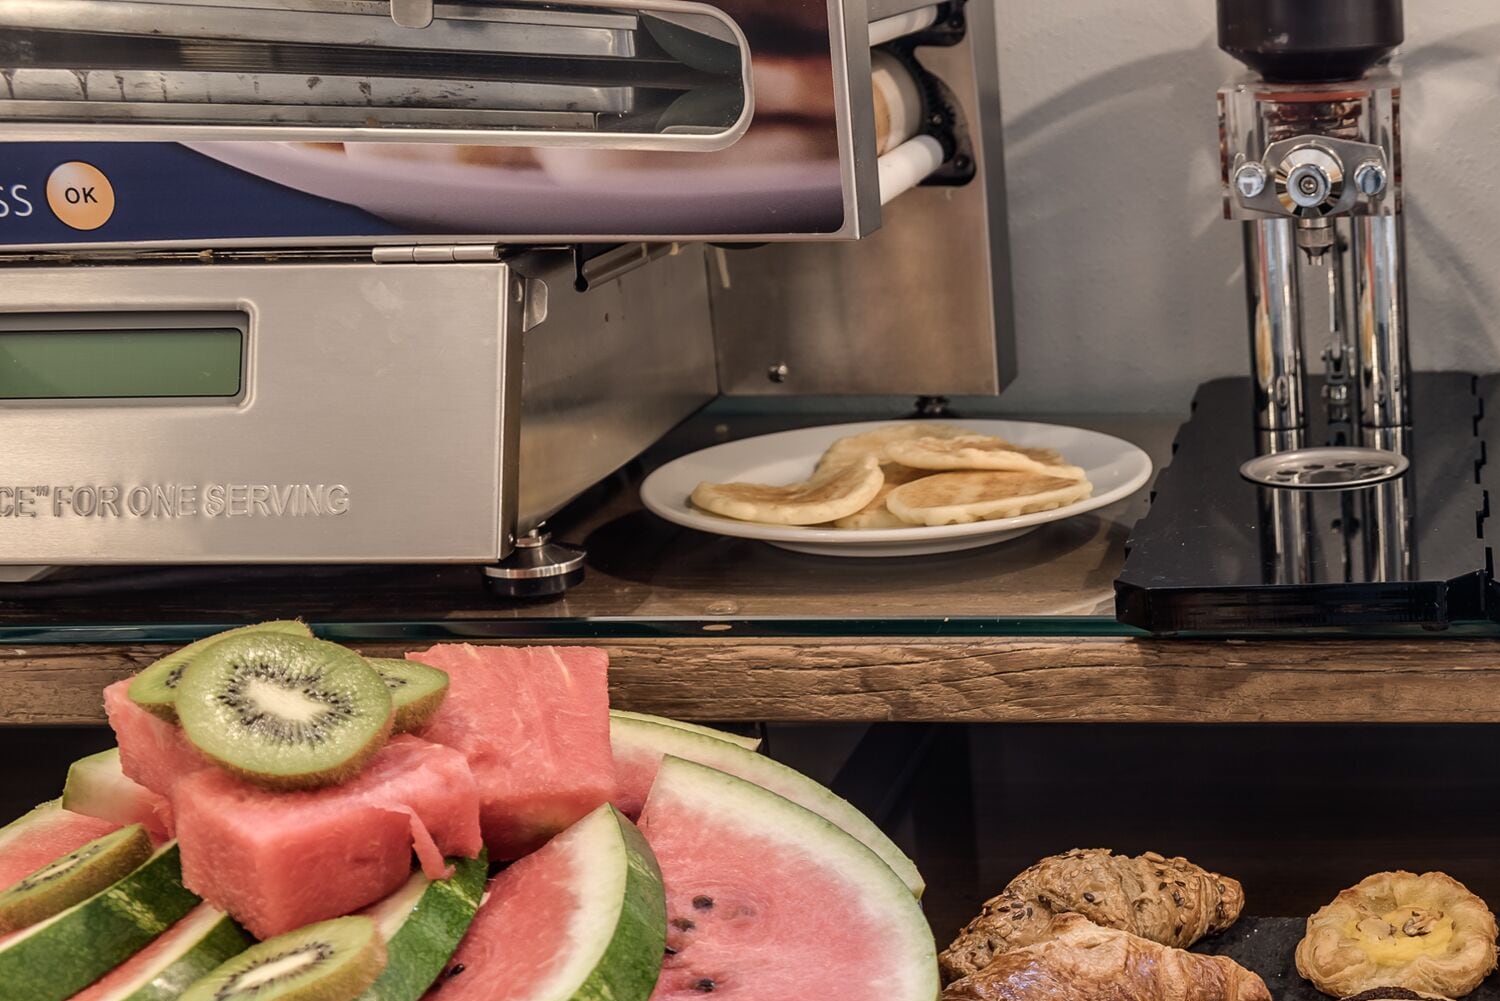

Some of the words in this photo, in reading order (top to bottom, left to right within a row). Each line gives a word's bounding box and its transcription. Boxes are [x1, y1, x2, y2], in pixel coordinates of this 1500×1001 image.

[64, 186, 98, 204] OK
[53, 485, 121, 518] FOR
[127, 484, 198, 518] ONE
[203, 483, 350, 518] SERVING
